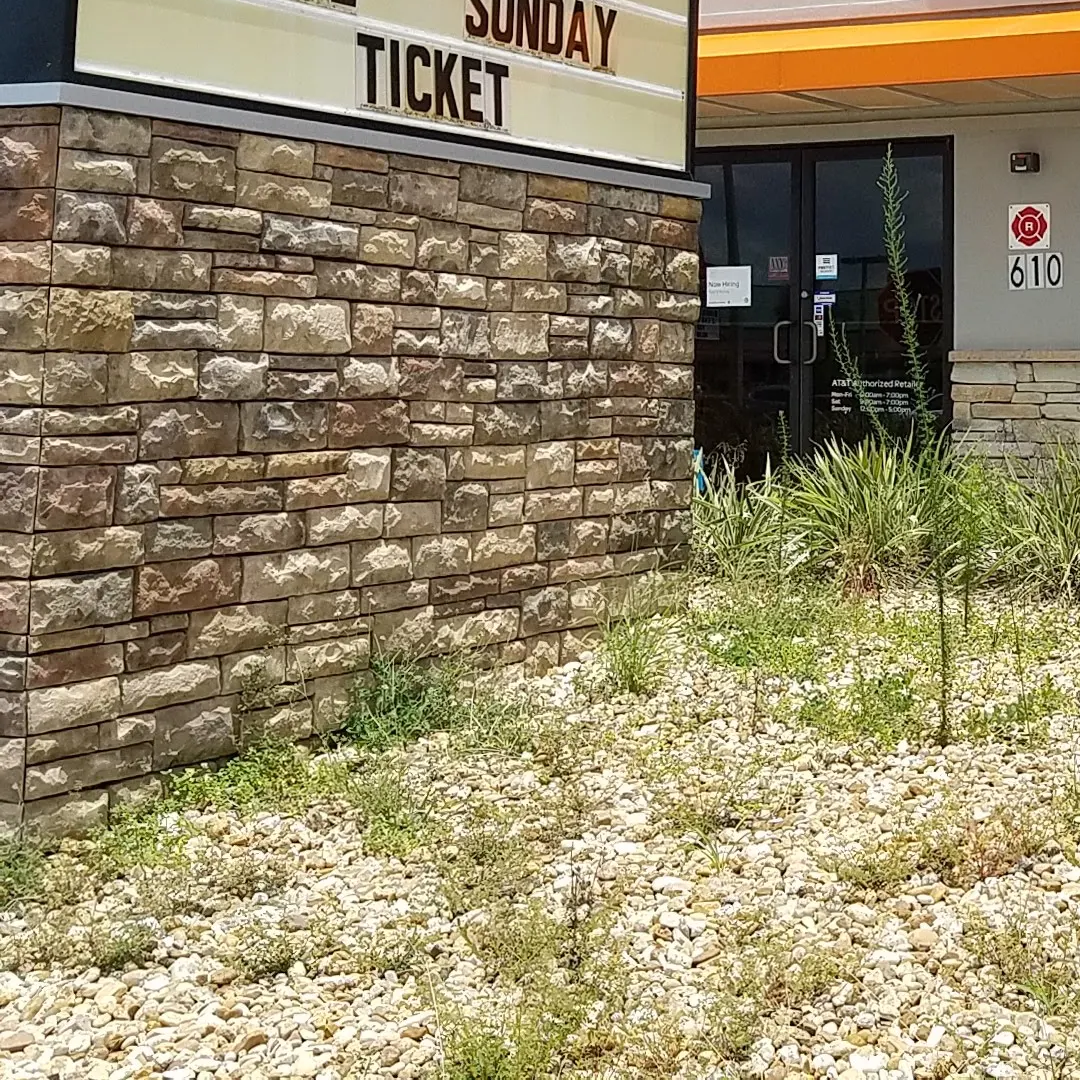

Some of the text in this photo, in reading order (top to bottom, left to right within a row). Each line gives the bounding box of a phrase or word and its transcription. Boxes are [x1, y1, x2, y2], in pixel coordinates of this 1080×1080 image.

[356, 32, 510, 128] TICKET
[1024, 221, 1034, 231] R
[1010, 254, 1061, 288] 610
